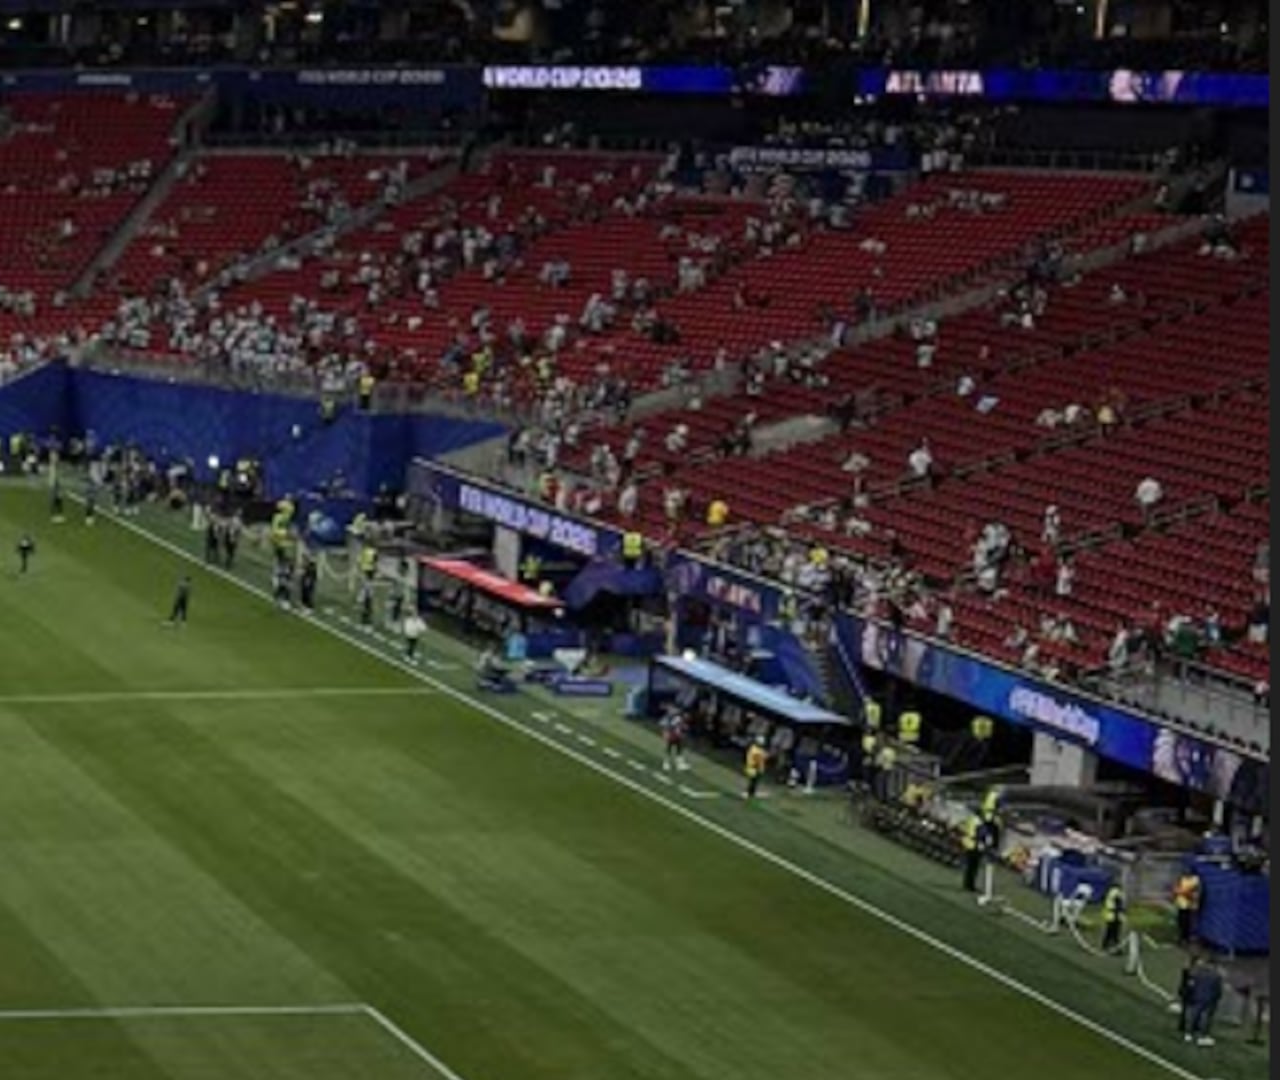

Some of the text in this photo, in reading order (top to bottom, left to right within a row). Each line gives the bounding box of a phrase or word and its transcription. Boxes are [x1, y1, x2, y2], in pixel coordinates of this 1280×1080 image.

[495, 66, 546, 90] WORLD
[547, 66, 579, 90] CUP
[885, 70, 985, 94] ATLANTA
